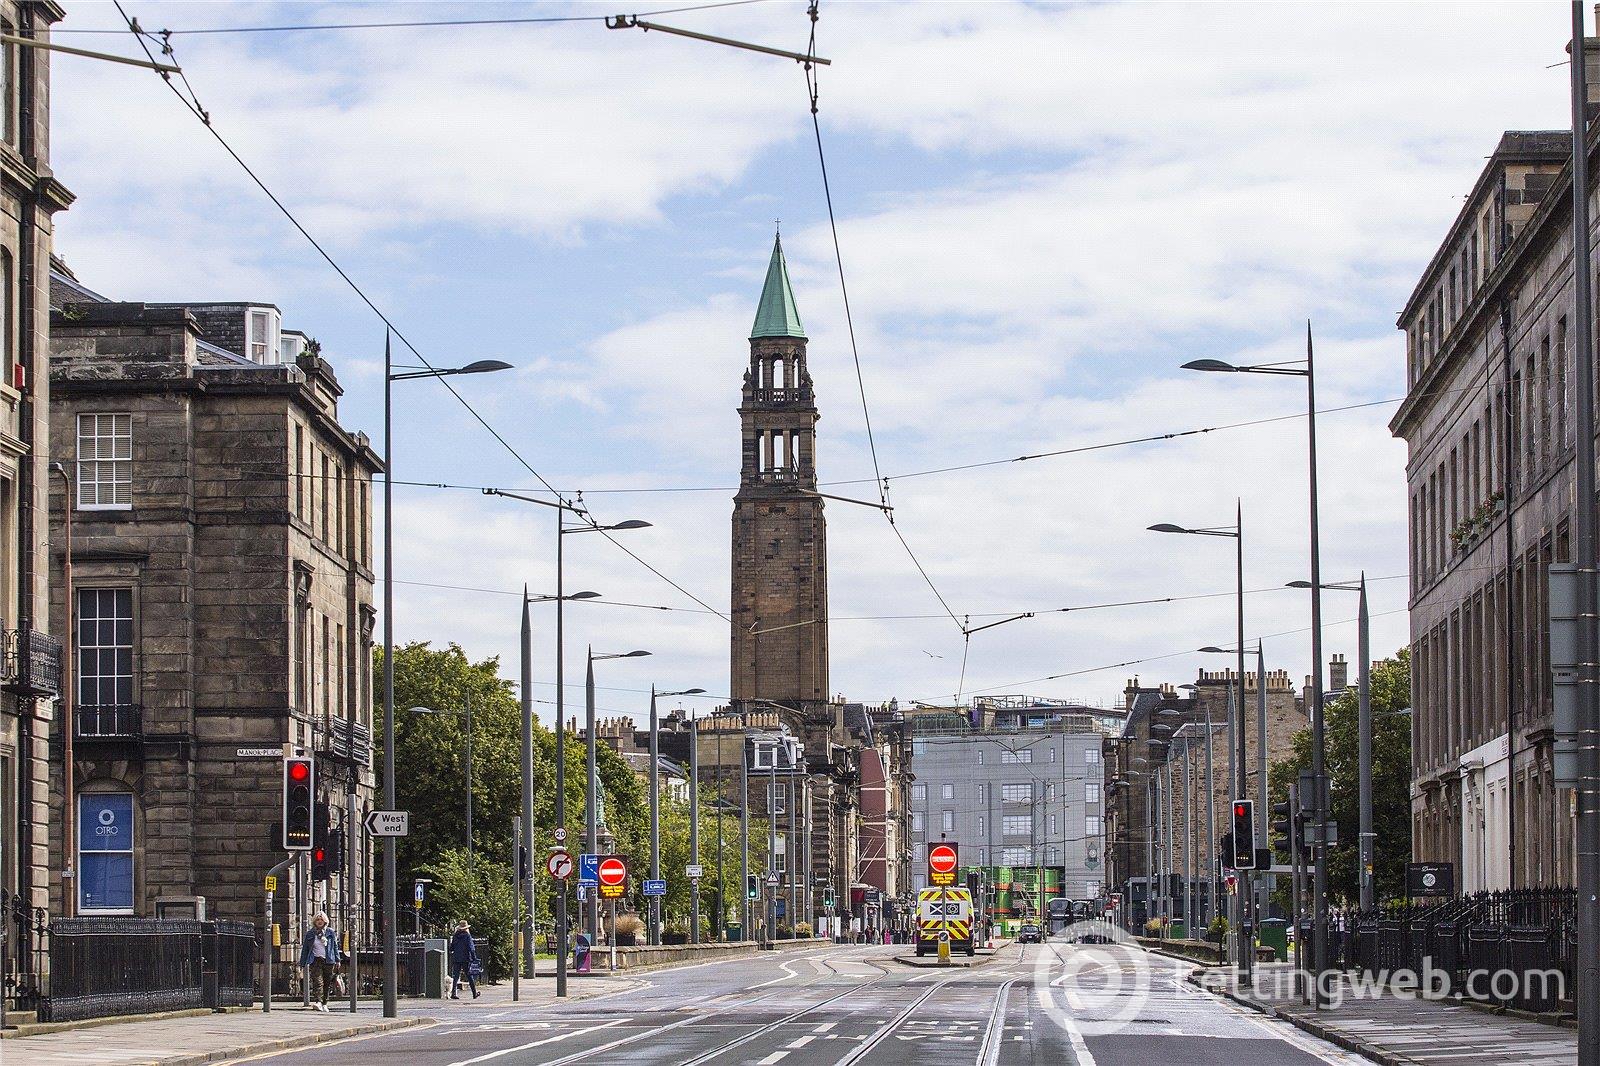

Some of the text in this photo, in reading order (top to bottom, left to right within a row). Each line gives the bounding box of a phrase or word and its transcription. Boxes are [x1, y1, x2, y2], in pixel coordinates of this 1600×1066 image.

[382, 814, 405, 823] West
[95, 826, 119, 835] OTRO
[384, 824, 402, 832] end
